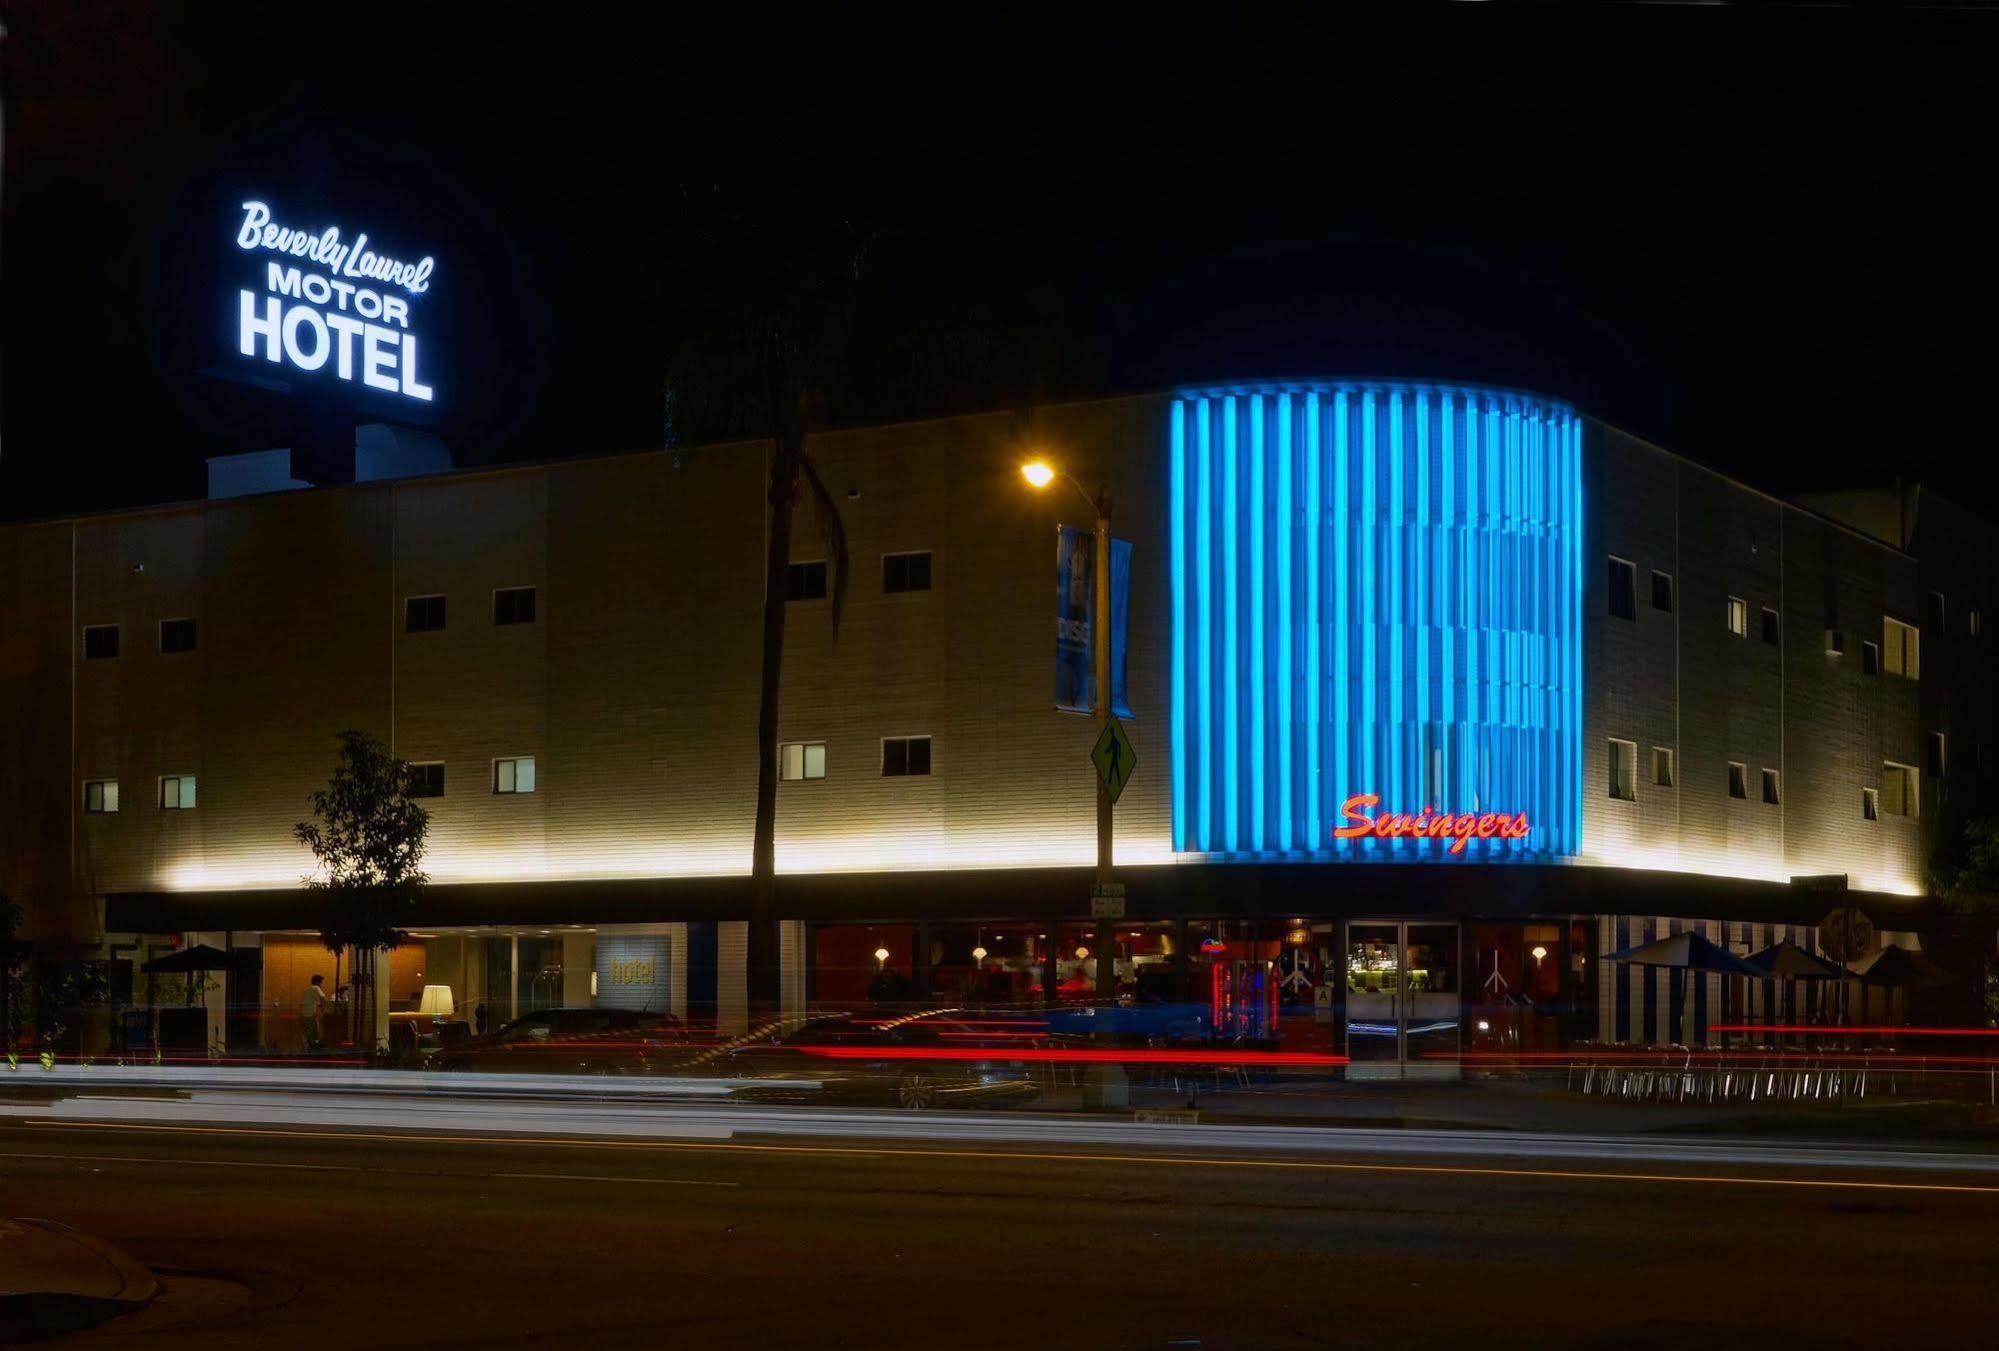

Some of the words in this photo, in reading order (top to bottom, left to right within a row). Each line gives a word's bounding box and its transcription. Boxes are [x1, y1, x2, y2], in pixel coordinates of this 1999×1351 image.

[237, 200, 350, 275] Beverly
[344, 233, 434, 293] Laurel
[268, 261, 408, 328] MOTOR
[240, 288, 433, 401] HOTEL
[1333, 794, 1531, 854] Swingers
